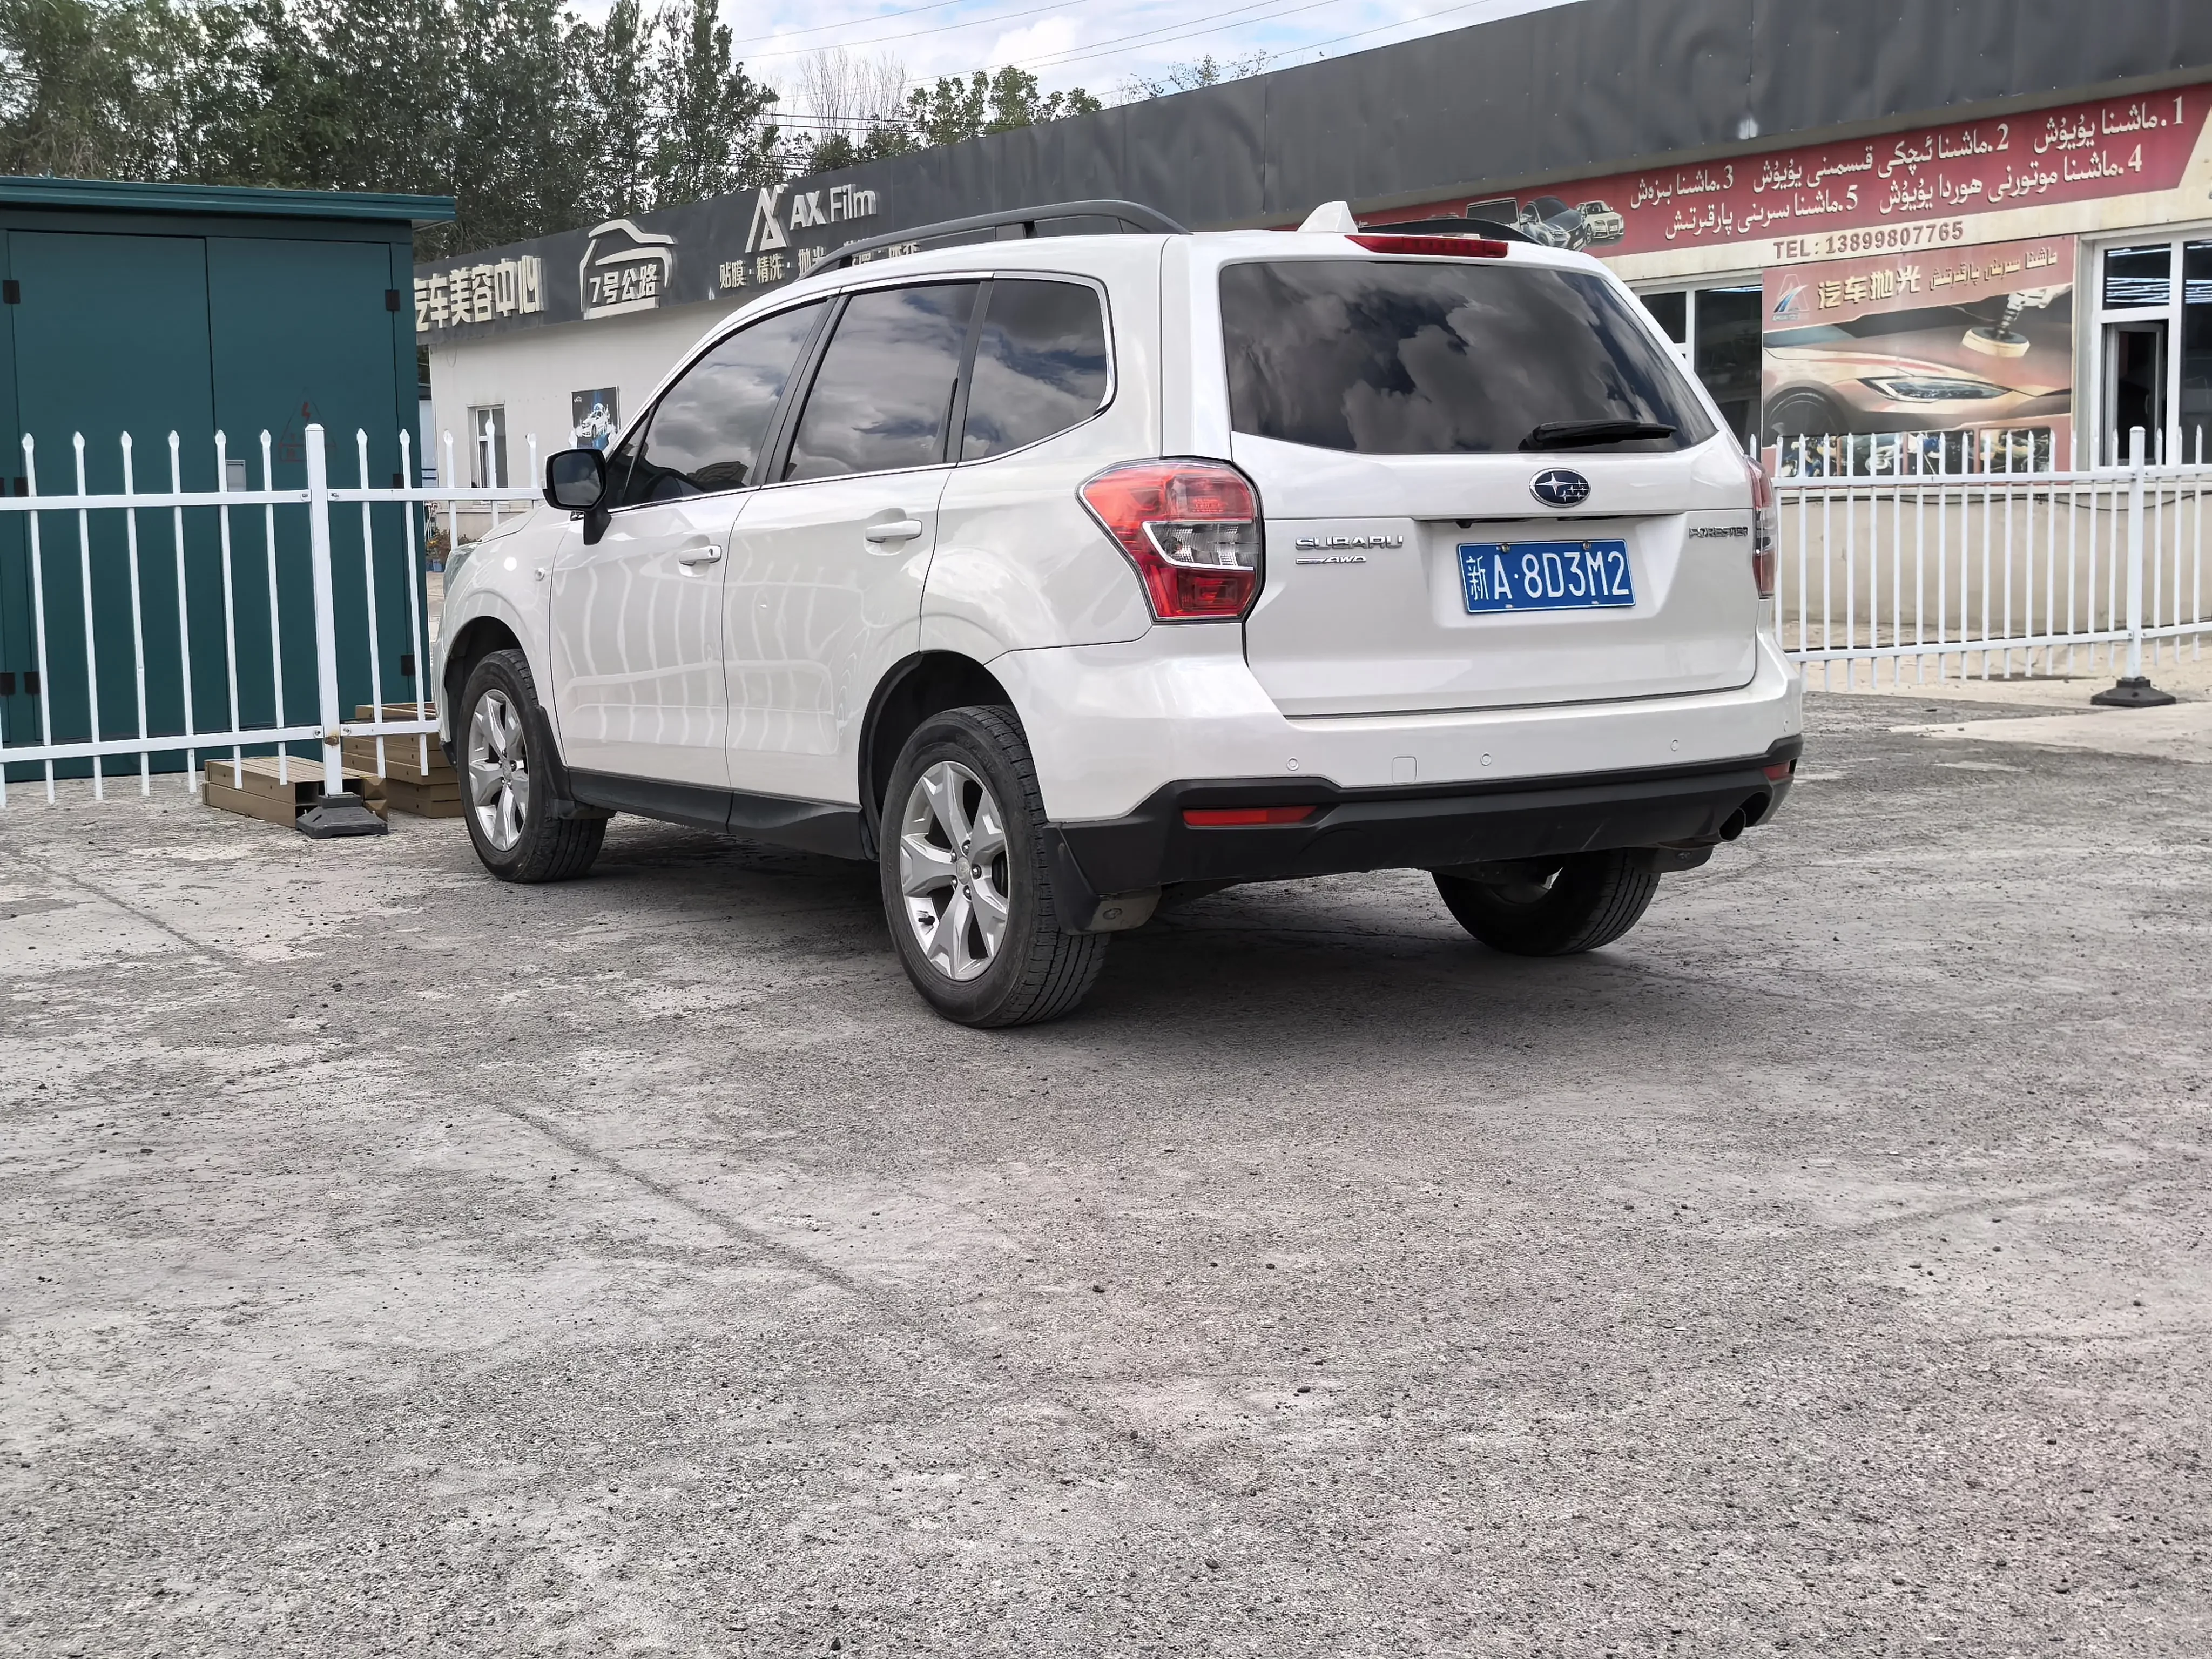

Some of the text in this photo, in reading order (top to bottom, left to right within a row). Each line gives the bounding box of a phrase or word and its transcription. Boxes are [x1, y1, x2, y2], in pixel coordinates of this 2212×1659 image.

[790, 184, 880, 231] AX Film
[589, 264, 658, 305] 7号公路
[1817, 265, 1922, 310] 汽车抛光
[1296, 535, 1404, 550] SUBARU
[1324, 555, 1367, 564] AWD
